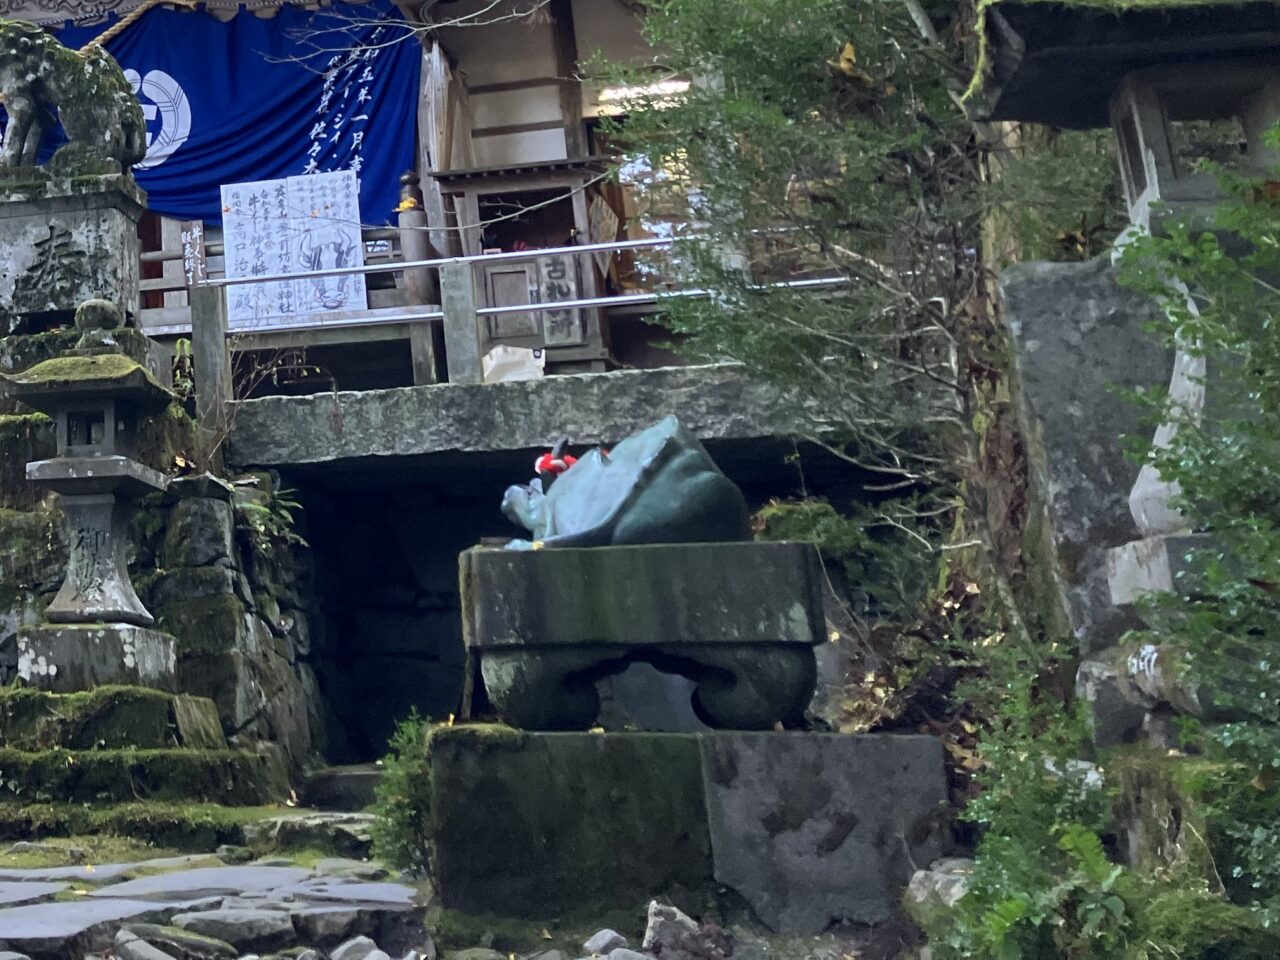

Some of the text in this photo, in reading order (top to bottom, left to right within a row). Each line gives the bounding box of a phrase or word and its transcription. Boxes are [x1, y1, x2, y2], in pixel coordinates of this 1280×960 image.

[350, 27, 386, 193] 令和五年一月吉
[181, 231, 196, 285] 販売終了
